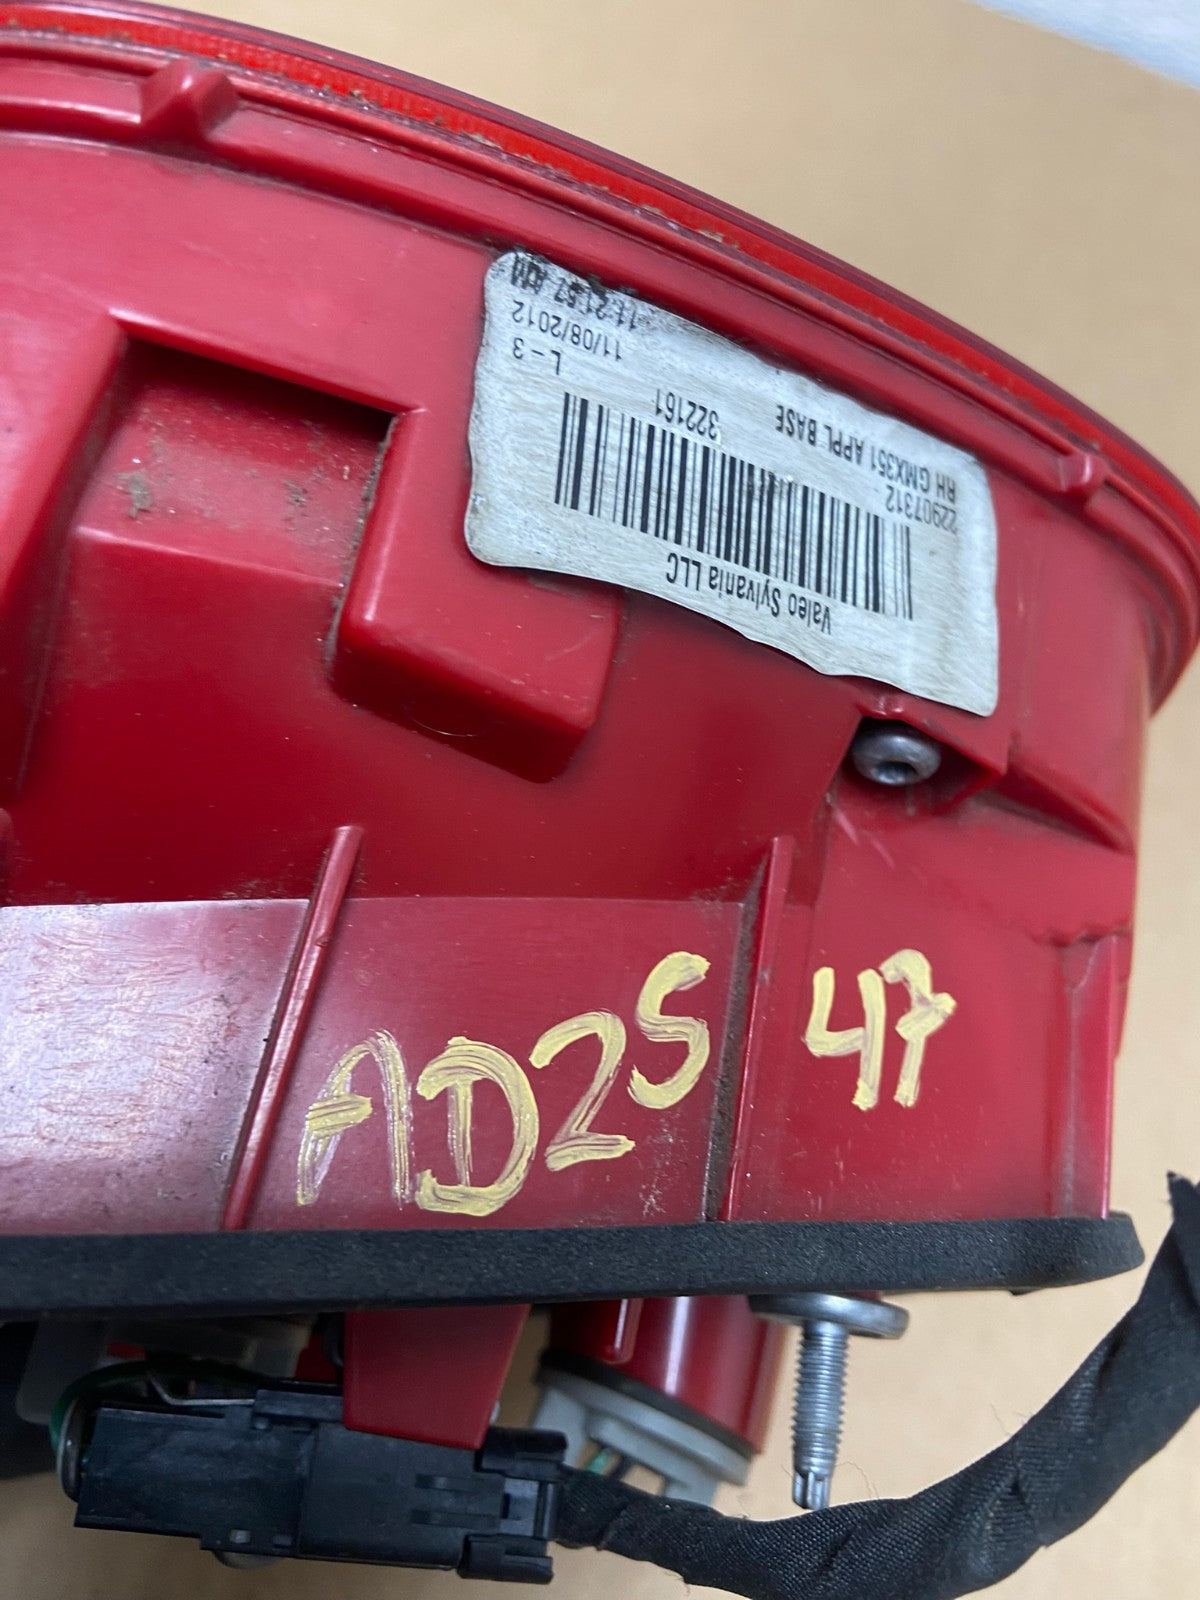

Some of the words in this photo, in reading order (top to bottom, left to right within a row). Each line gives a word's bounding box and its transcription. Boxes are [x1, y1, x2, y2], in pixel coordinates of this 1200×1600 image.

[511, 300, 622, 362] 11/08/2012
[653, 388, 719, 440] 322161
[775, 404, 817, 445] BASE
[824, 424, 865, 464] APPL
[870, 442, 930, 494] GMX351
[885, 485, 958, 534] 22907312
[936, 474, 957, 501] RH
[666, 552, 702, 592] LLC
[708, 565, 781, 619] Sylvania
[788, 592, 832, 636] Valeo
[804, 949, 957, 1111] 47
